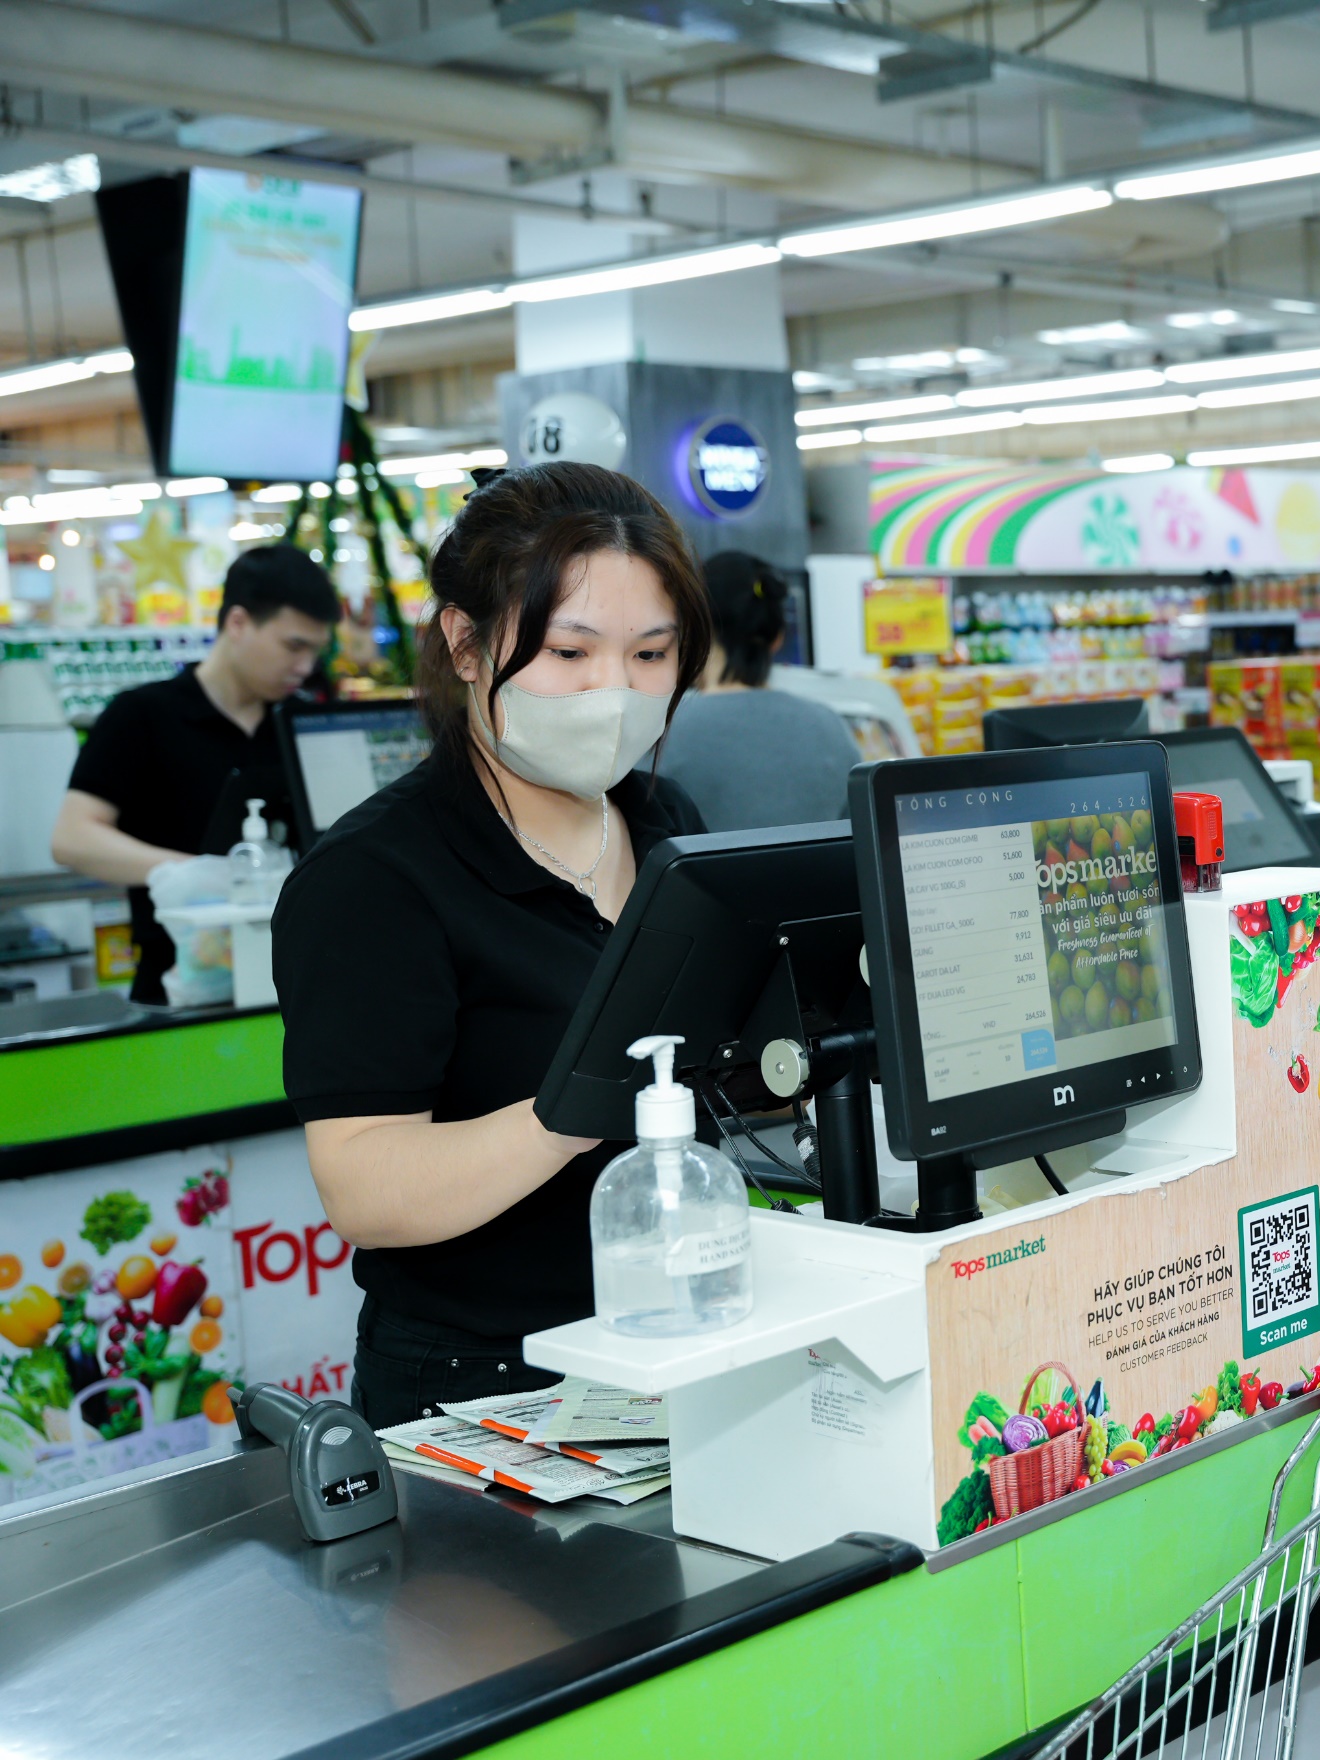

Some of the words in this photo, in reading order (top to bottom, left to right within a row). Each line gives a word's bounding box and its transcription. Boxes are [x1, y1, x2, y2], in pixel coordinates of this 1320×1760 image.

[1000, 829, 1021, 839] 63,800
[1003, 850, 1023, 861] 51,600
[1008, 871, 1025, 881] 5,000
[1009, 909, 1029, 920] 77,800
[1055, 893, 1088, 916] phẩm
[1090, 891, 1115, 907] luôn
[1117, 886, 1139, 903] tươi
[1052, 918, 1070, 934] với
[1073, 914, 1091, 933] giá
[1094, 911, 1116, 928] siêu
[1119, 912, 1132, 923] ưu
[1135, 905, 1153, 920] đãi
[1015, 930, 1031, 941] 9,912
[1057, 936, 1098, 952] Freshness
[916, 967, 937, 980] CAROT
[1014, 952, 1034, 963] 31,631
[1076, 952, 1118, 968] Affordable
[1119, 947, 1138, 960] Price
[1016, 972, 1036, 984] 24,783
[950, 1256, 986, 1281] Tops
[986, 1234, 1046, 1270] market
[1272, 1249, 1290, 1264] Tops
[1094, 1280, 1120, 1302] HÃY
[1124, 1269, 1154, 1292] GIÚP
[1158, 1254, 1202, 1280] CHÚNG
[1205, 1244, 1225, 1264] TÔI
[1087, 1303, 1123, 1327] PHỤC
[1127, 1294, 1145, 1312] VỤ
[1149, 1284, 1175, 1306] BẠN
[1179, 1272, 1203, 1295] TỐT
[1206, 1265, 1233, 1286] HƠN
[1088, 1330, 1113, 1349] HELP
[1115, 1324, 1128, 1339] US
[1131, 1319, 1144, 1333] TO
[1146, 1308, 1176, 1328] SERVE
[1178, 1300, 1198, 1316] YOU
[1200, 1287, 1234, 1309] BETTER
[1260, 1326, 1288, 1346] Scan
[1290, 1318, 1308, 1334] me
[1106, 1345, 1131, 1361] ĐÁNH
[1132, 1335, 1147, 1351] GIÁ
[1149, 1329, 1166, 1345] CỦA
[1168, 1321, 1196, 1338] KHÁCH
[1197, 1311, 1220, 1327] HÀNG
[1120, 1348, 1165, 1373] CUSTOMER
[1166, 1331, 1209, 1356] FEEDBACK
